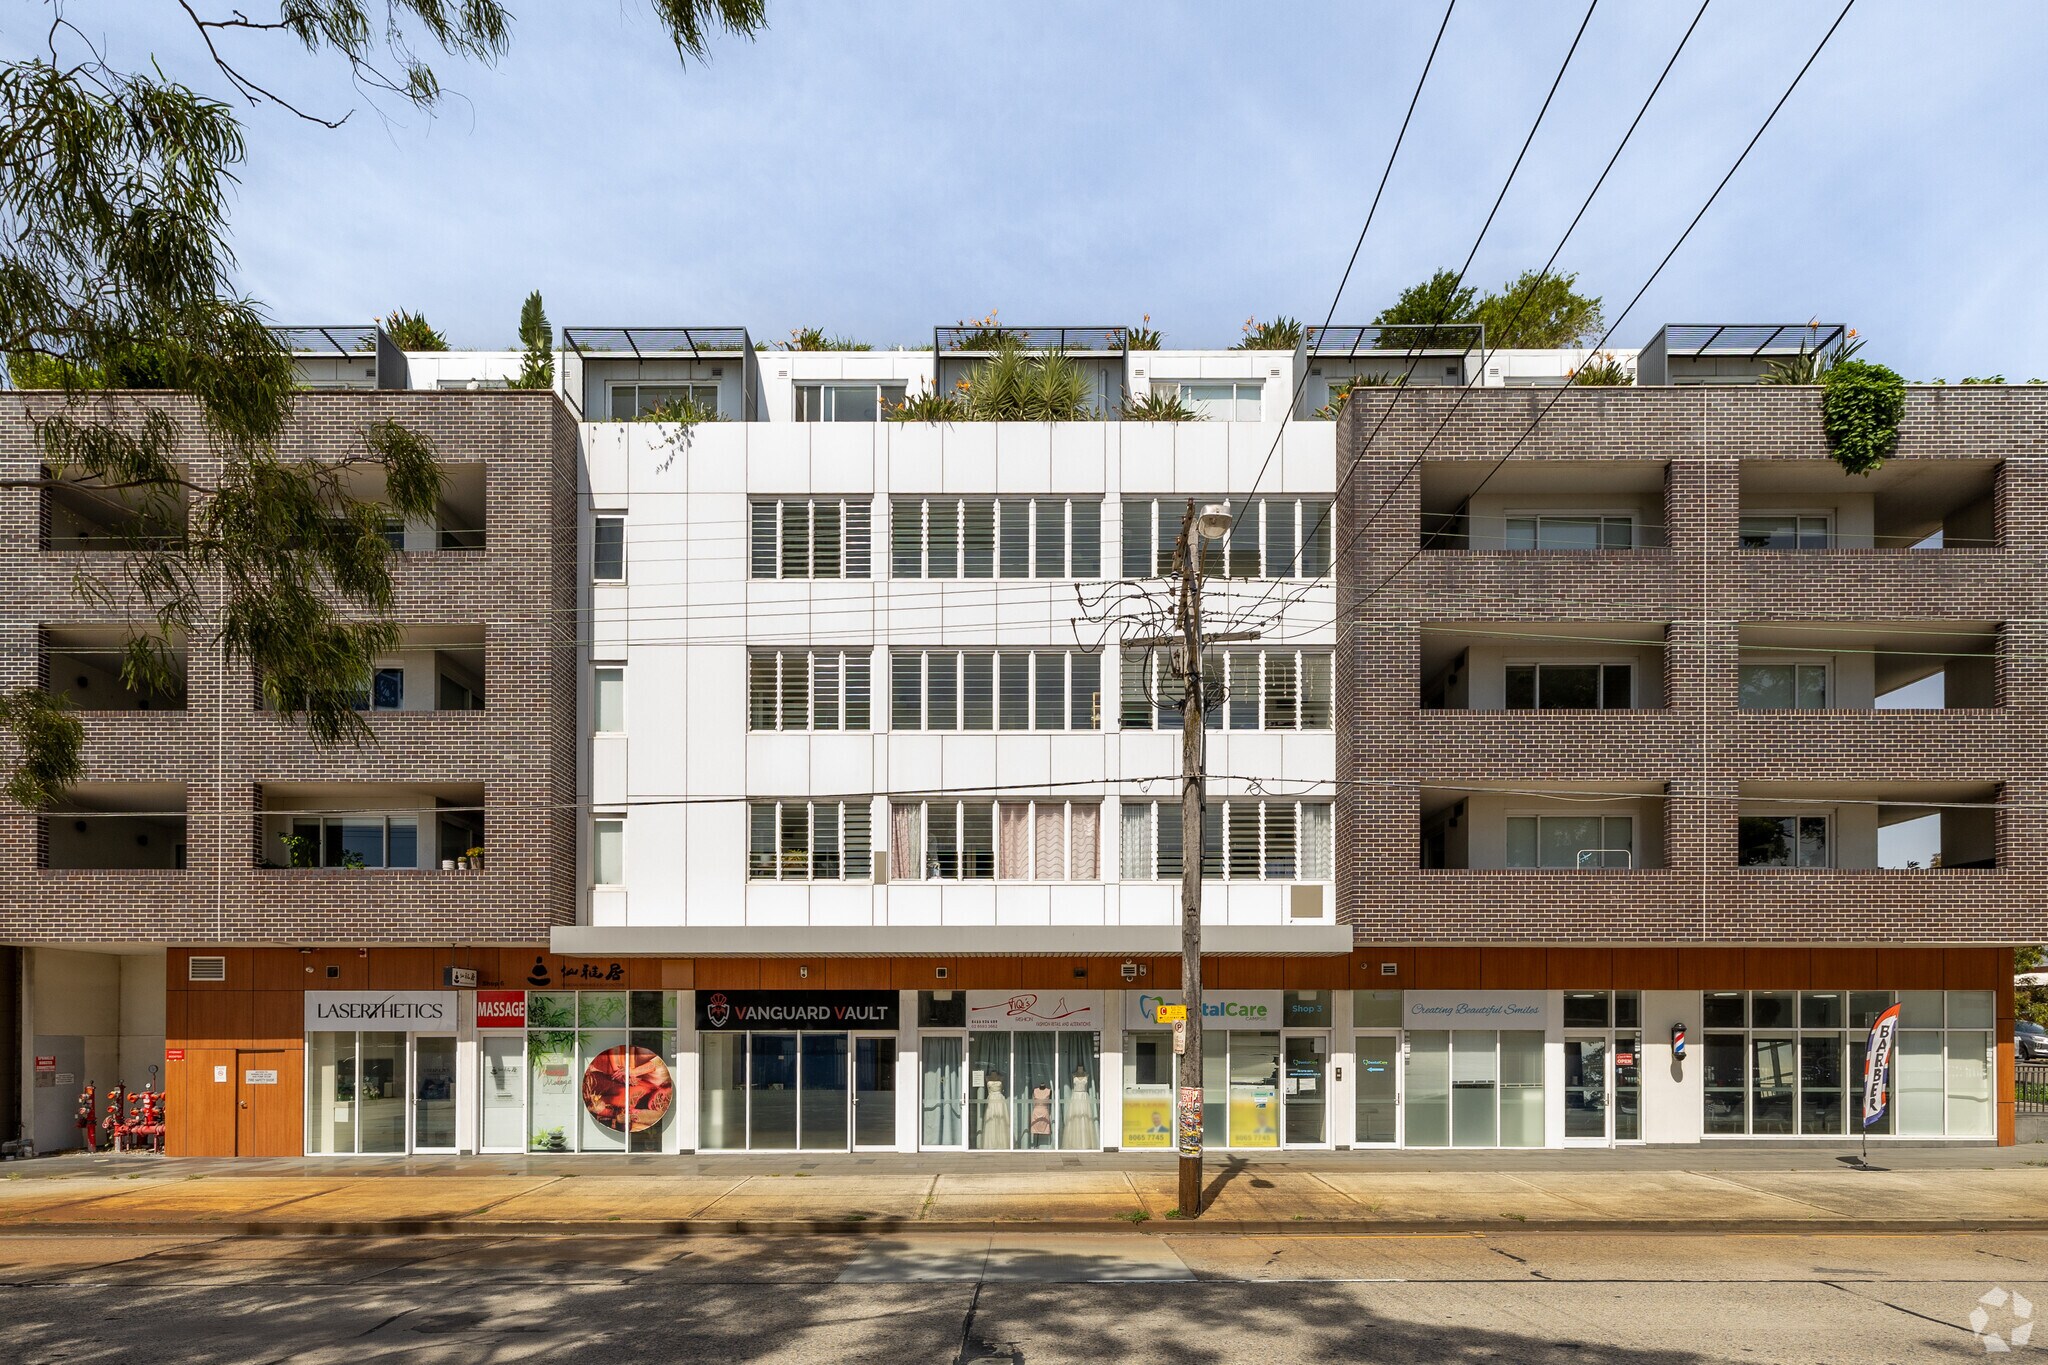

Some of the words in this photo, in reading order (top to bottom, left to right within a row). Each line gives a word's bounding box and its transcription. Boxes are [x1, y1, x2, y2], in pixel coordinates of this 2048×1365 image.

[477, 1001, 525, 1017] MASSAGE
[735, 1006, 831, 1020] VANGUARD
[834, 1006, 888, 1020] VAULT
[1292, 1004, 1315, 1014] Shop
[1411, 1004, 1454, 1016] Creating
[1455, 1003, 1502, 1016] Beautiful
[1504, 1004, 1540, 1015] Smiles
[1869, 1025, 1890, 1111] BARBER
